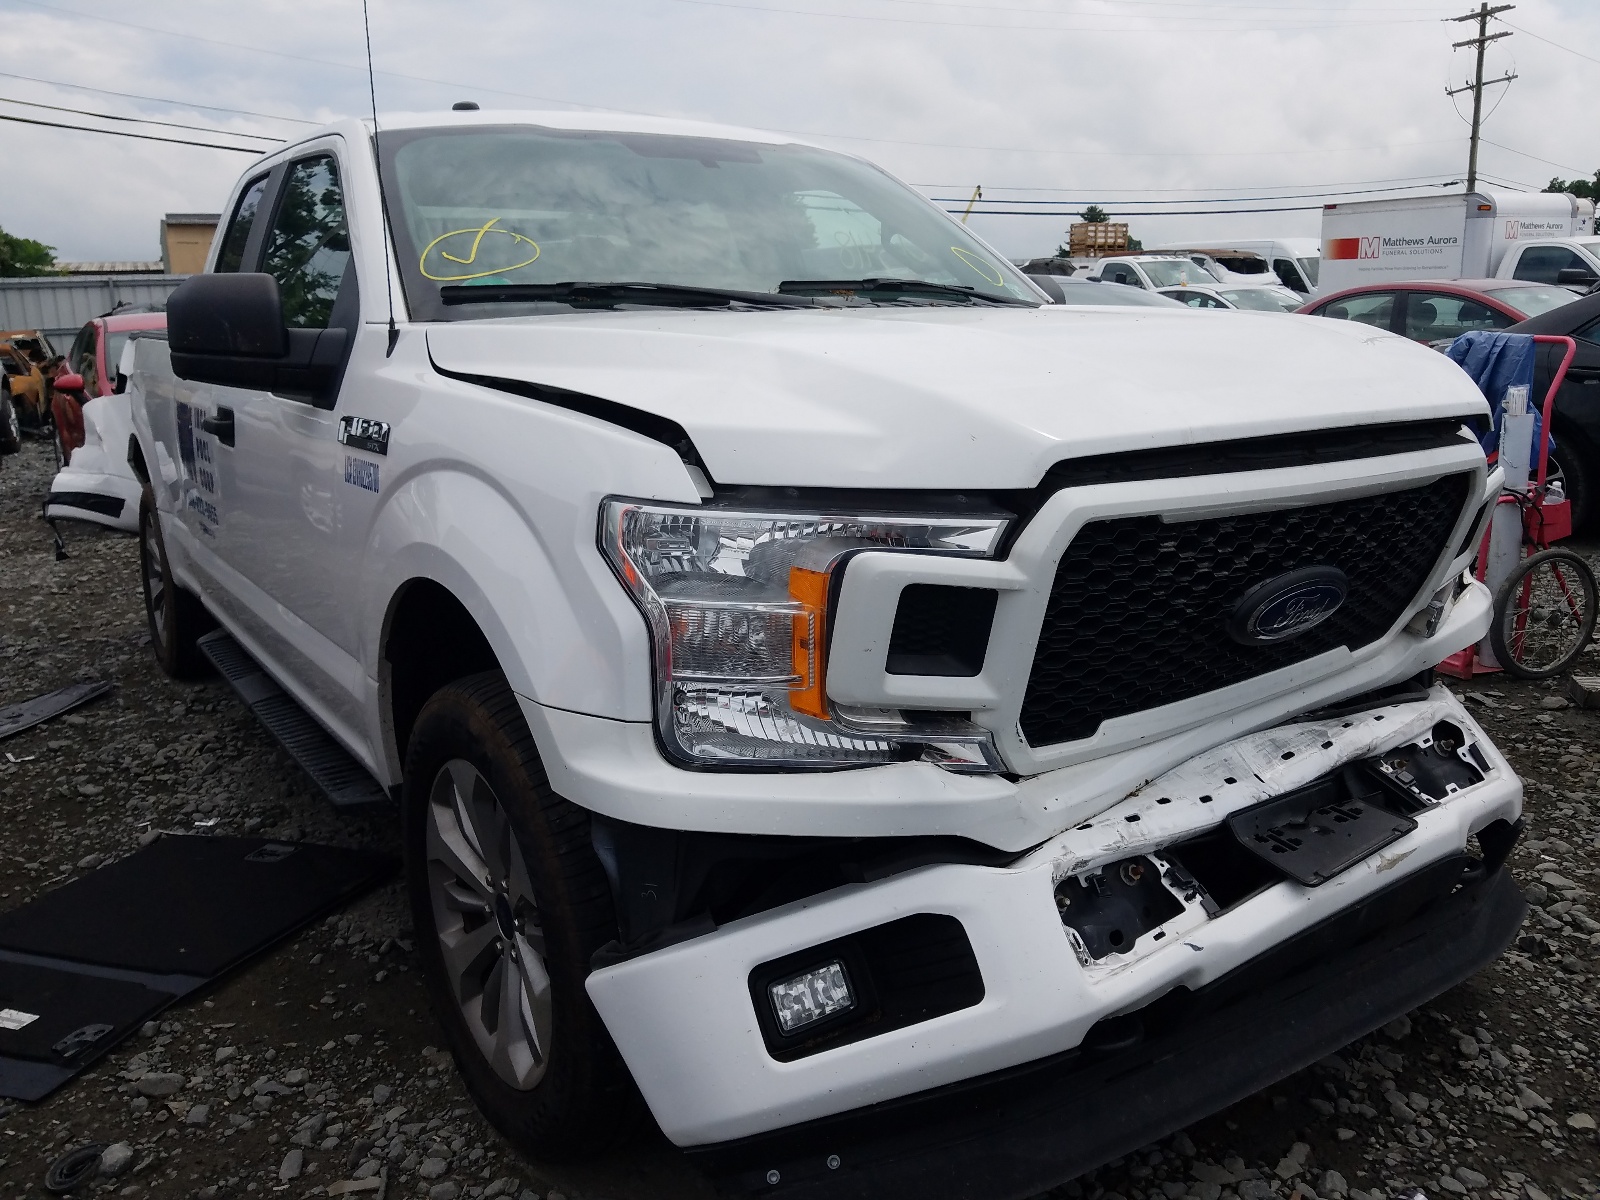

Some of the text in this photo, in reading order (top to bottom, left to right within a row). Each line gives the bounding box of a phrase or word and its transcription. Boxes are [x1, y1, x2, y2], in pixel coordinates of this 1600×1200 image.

[1520, 222, 1563, 230] Matthews Aurora
[1382, 235, 1458, 247] Matthews Aurora
[1262, 594, 1331, 630] Ford
